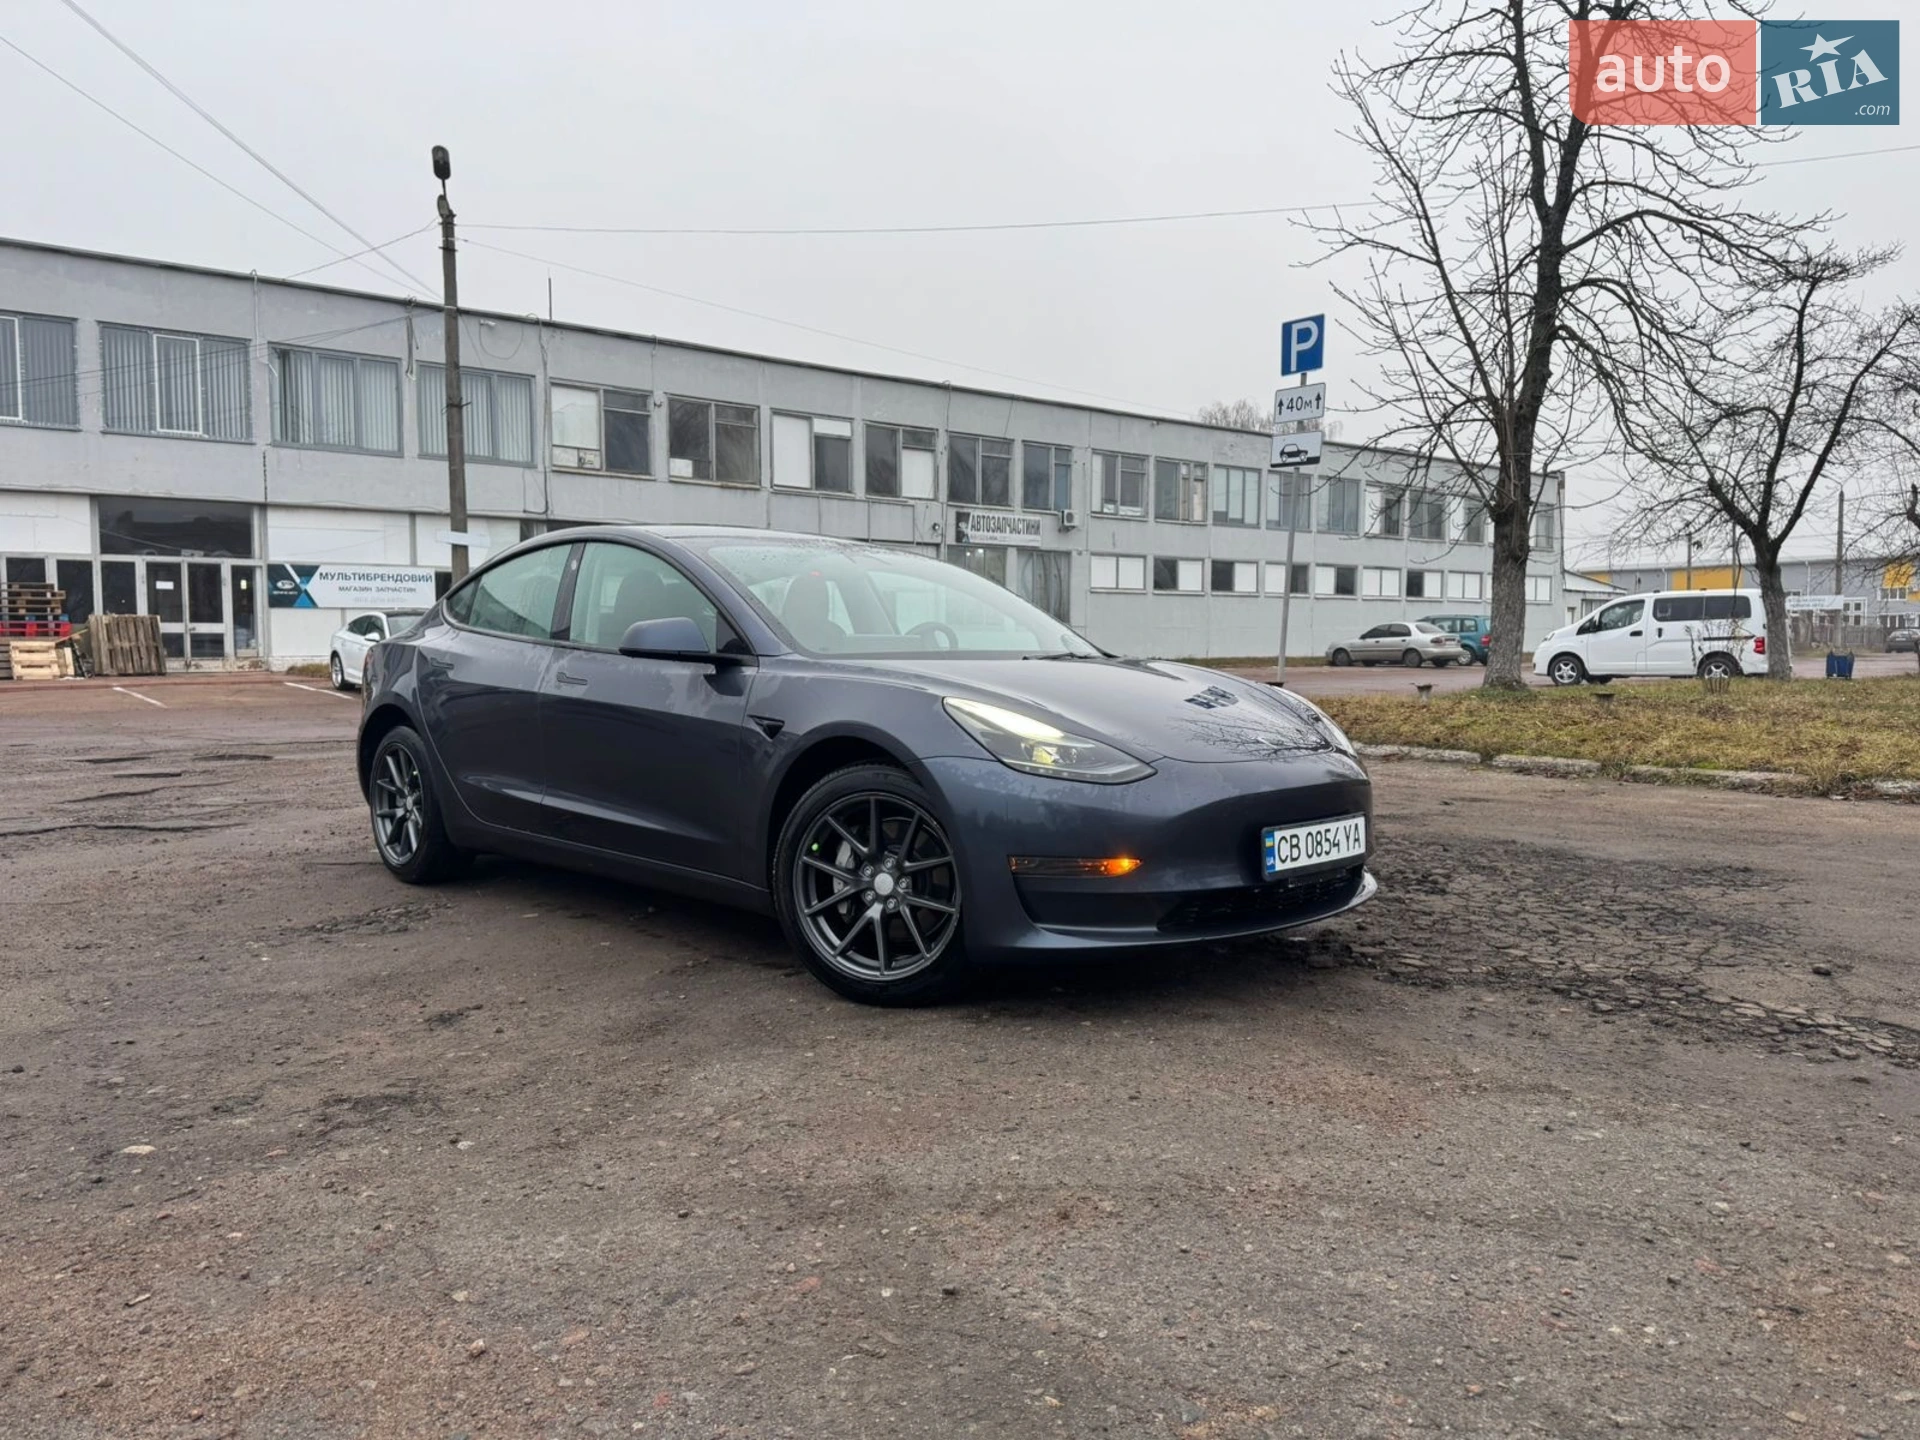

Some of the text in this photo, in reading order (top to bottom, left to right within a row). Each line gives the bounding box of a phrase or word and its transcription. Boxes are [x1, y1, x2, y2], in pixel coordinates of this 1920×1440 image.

[1290, 319, 1319, 372] P
[970, 514, 1041, 536] АВТОЗАПЧАСТИНИ
[319, 571, 433, 583] МУЛЬТИБРЕНДОВИЙ
[1277, 822, 1361, 863] CB 0854 YA
